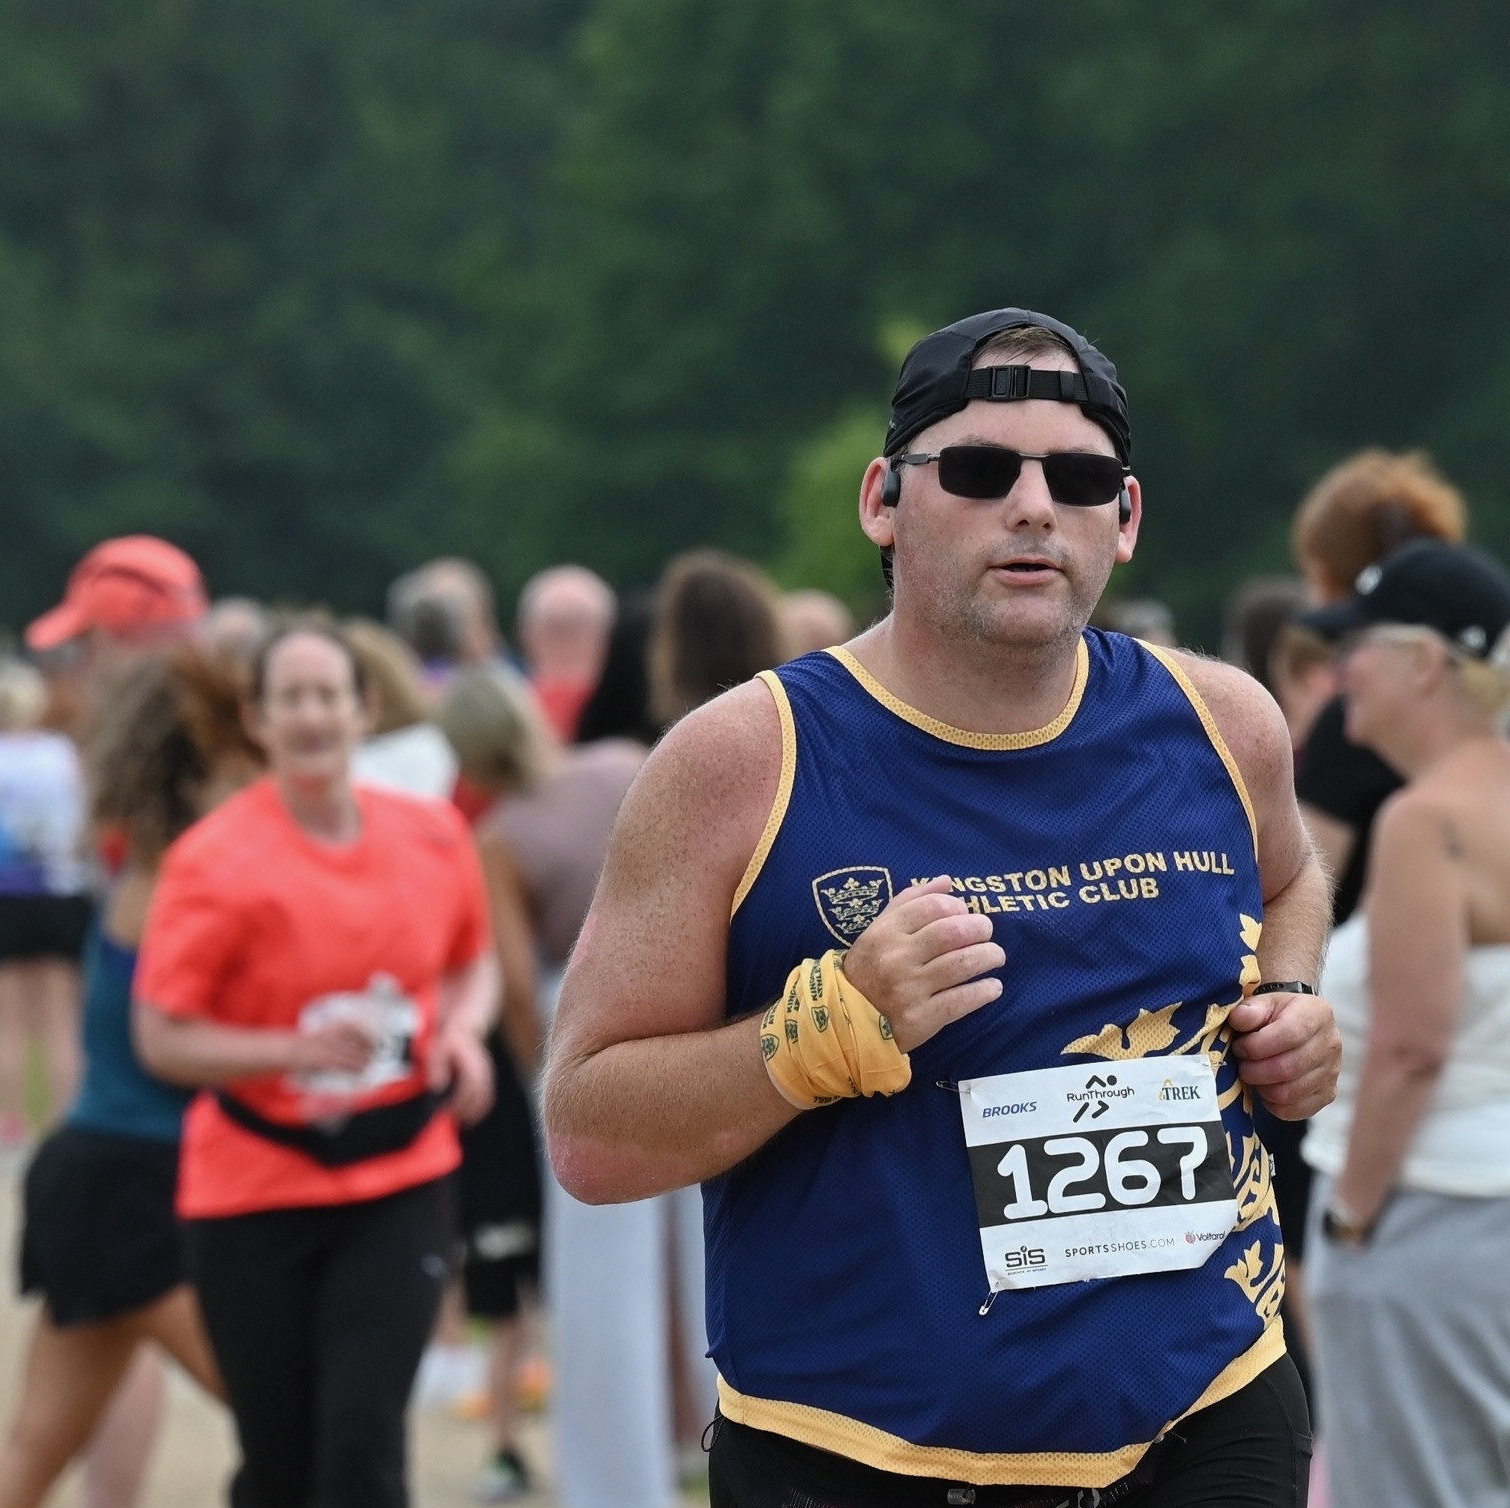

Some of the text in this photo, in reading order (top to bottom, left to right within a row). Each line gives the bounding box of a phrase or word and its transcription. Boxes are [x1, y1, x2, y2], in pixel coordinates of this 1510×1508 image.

[911, 851, 1235, 893] KNGSTON UPON HULL
[959, 878, 1159, 914] HLETIC CLUB
[1067, 1086, 1135, 1103] RunThrough
[1162, 1086, 1201, 1101] TREK
[982, 1101, 1037, 1118] BROOKS
[997, 1126, 1208, 1220] 1267
